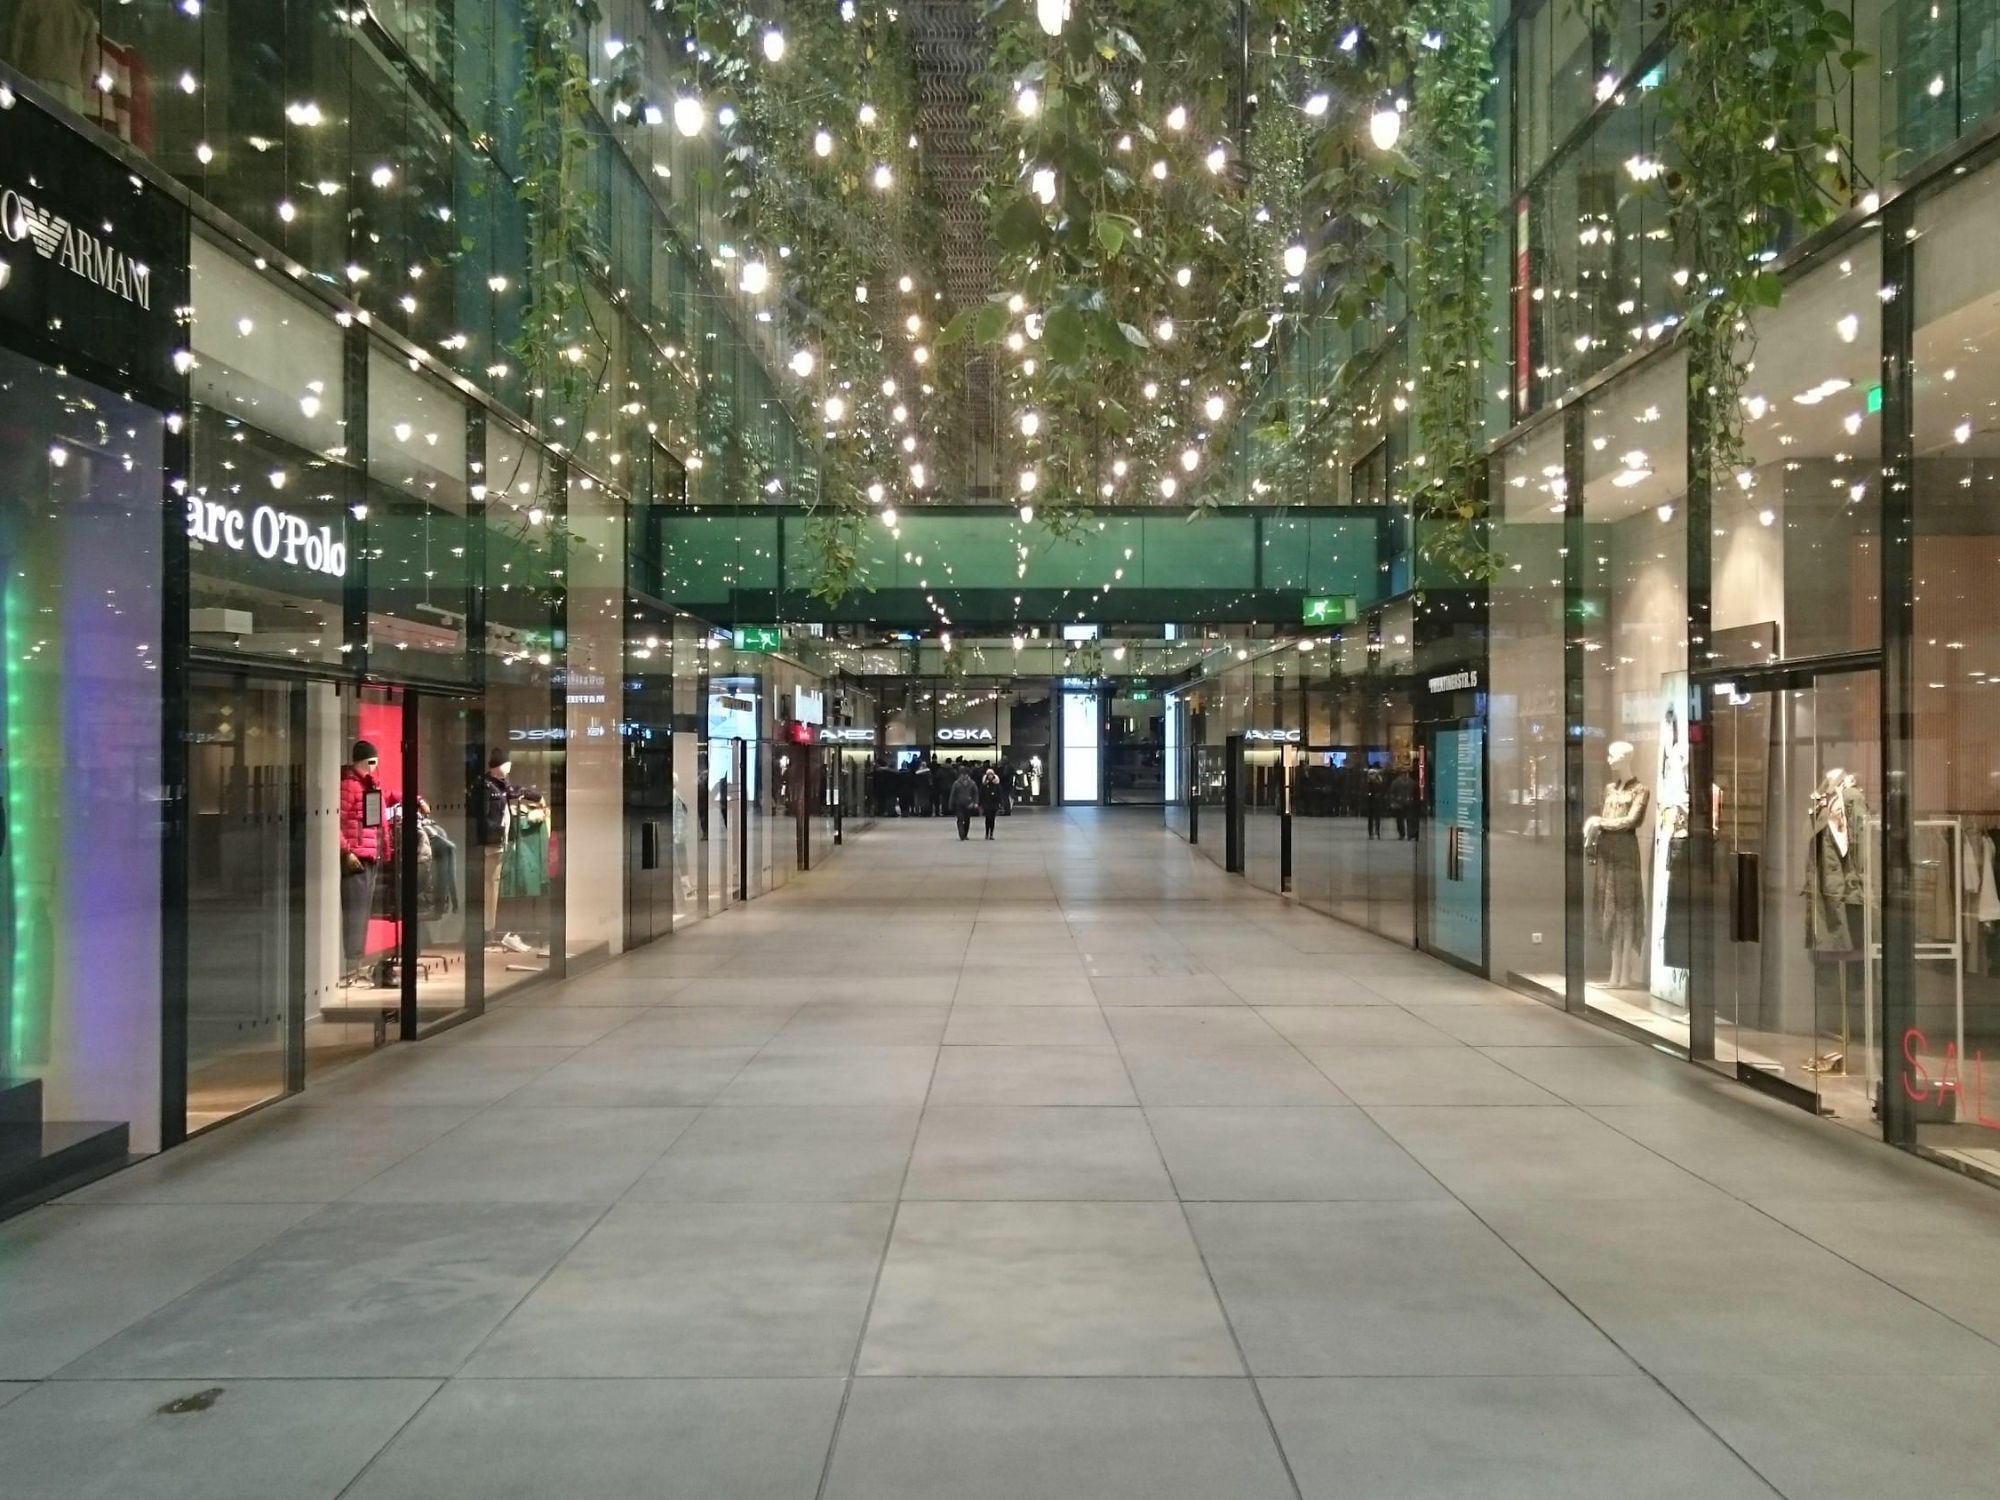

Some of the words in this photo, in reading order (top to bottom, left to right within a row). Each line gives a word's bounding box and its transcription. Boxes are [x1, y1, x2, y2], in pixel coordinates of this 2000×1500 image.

[59, 223, 150, 311] ARMANI
[252, 506, 346, 577] O'Polo
[937, 728, 993, 740] OSKA
